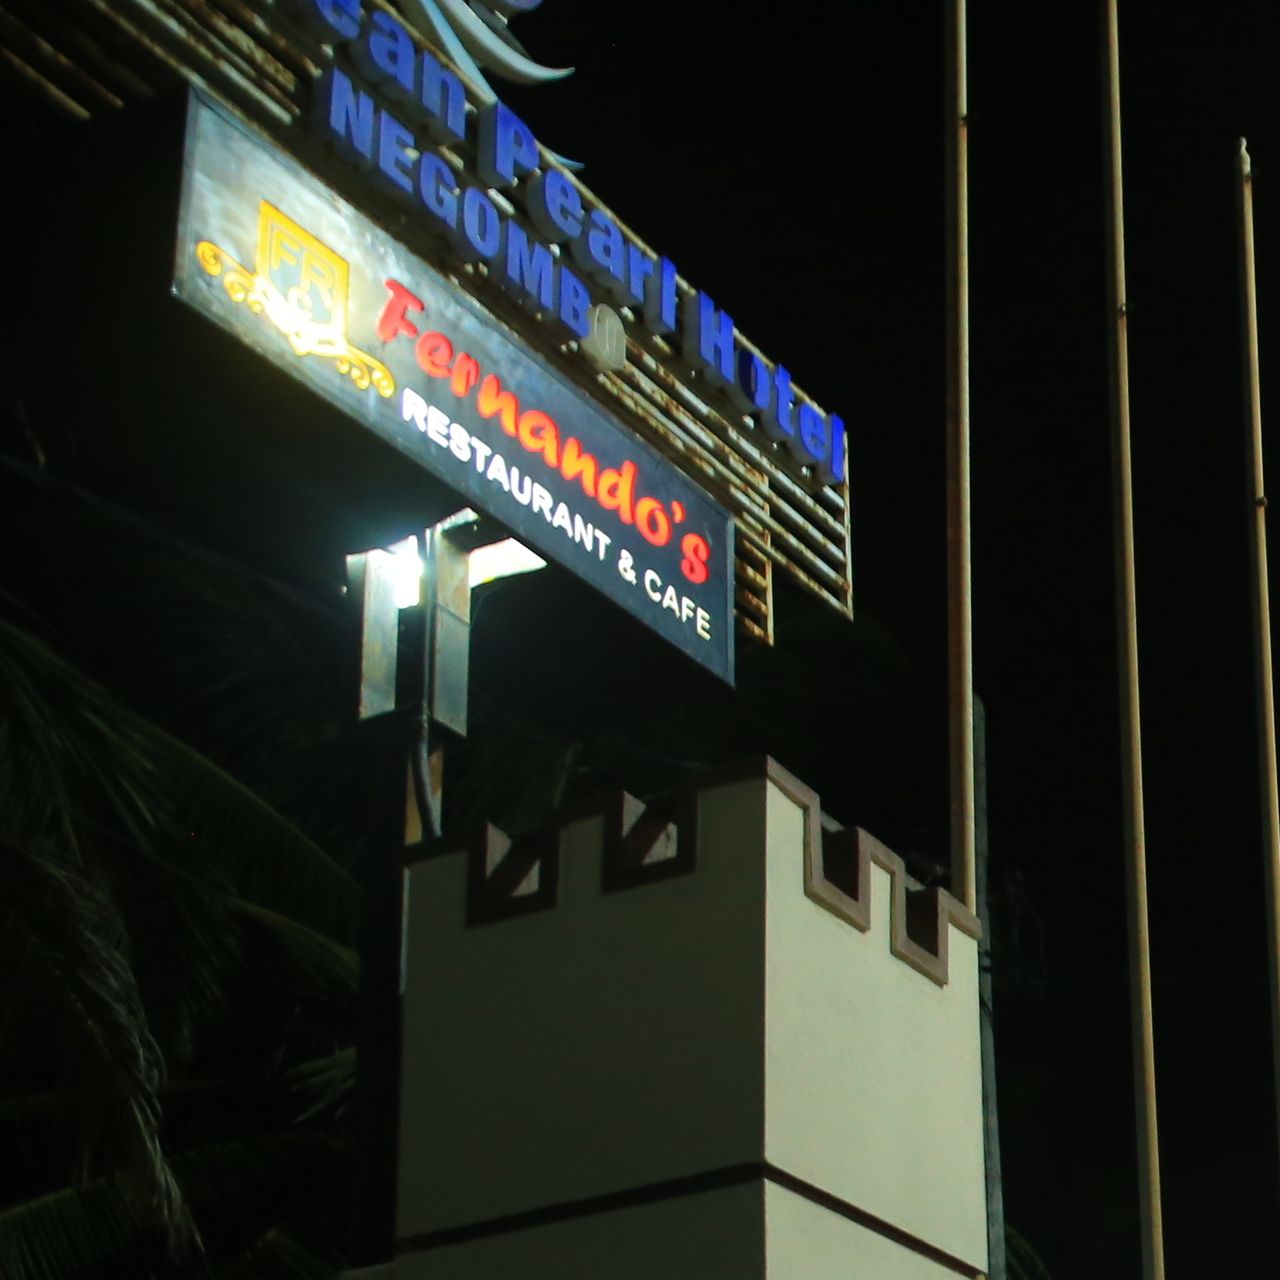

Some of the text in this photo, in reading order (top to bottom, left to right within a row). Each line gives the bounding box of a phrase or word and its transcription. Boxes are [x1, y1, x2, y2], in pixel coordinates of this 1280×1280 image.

[376, 278, 710, 584] Fernando's
[490, 100, 678, 333] Pearl
[696, 290, 845, 479] Hotel
[401, 387, 712, 641] RESTAURANT & CAFE
